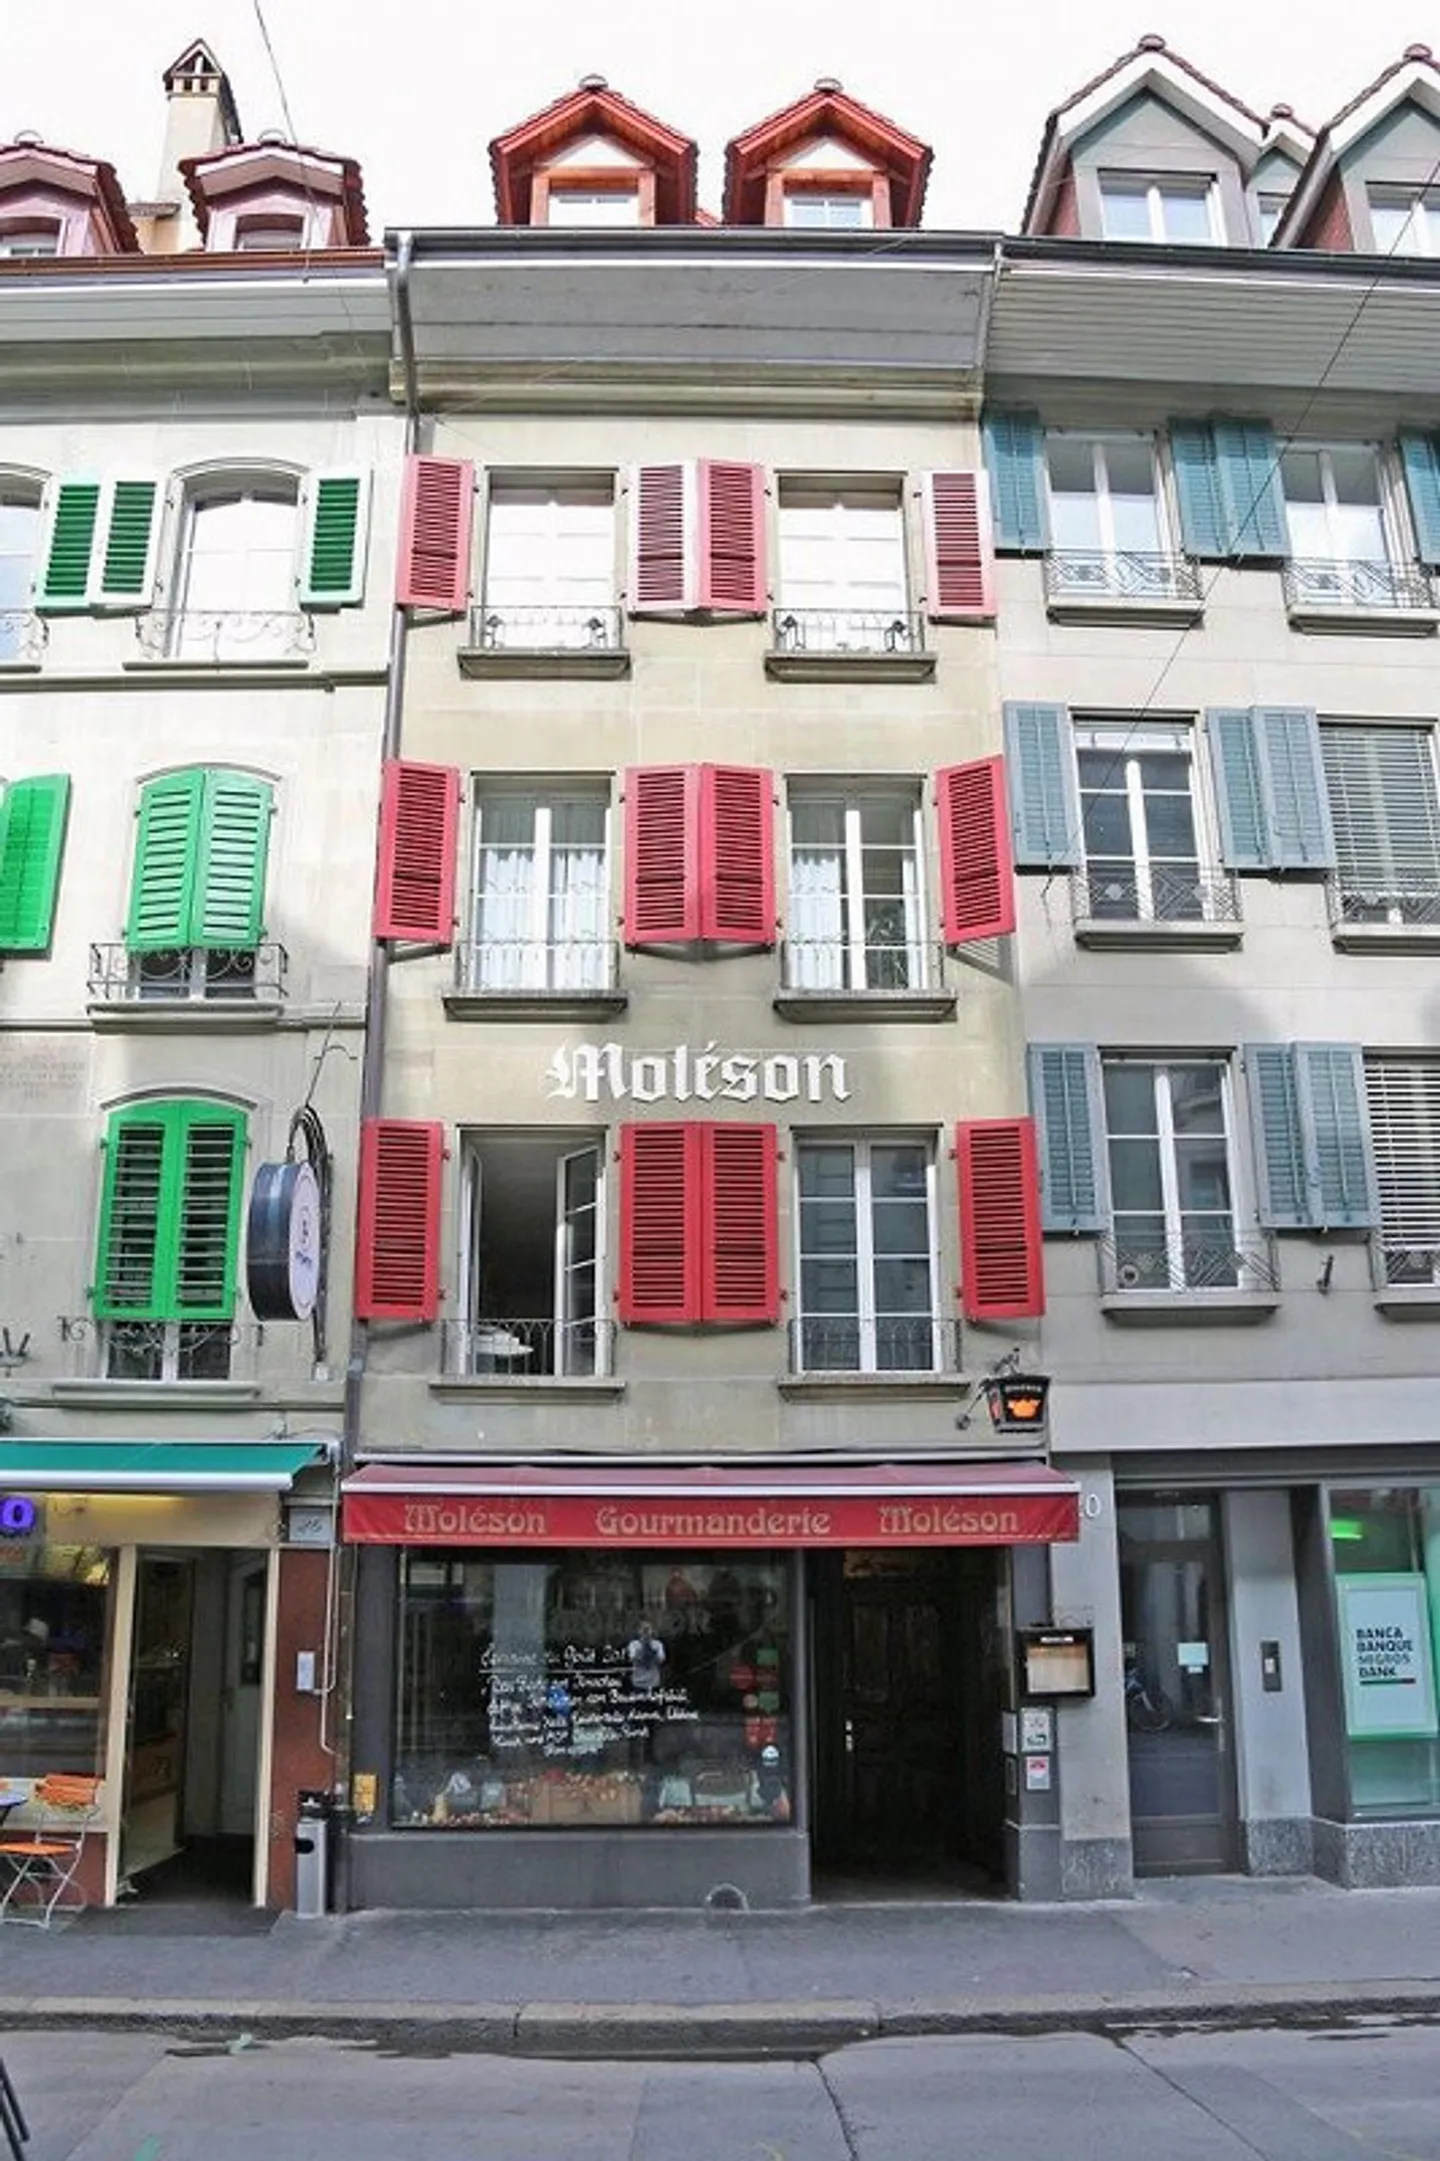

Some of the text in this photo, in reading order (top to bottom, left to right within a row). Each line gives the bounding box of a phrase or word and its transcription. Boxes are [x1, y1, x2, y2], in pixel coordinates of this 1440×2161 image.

[546, 1041, 851, 1103] Moléson
[404, 1504, 1019, 1536] Moléson Gourmanderie Moléson
[1356, 1626, 1403, 1639] BANCA
[1356, 1639, 1414, 1652] BANQUE
